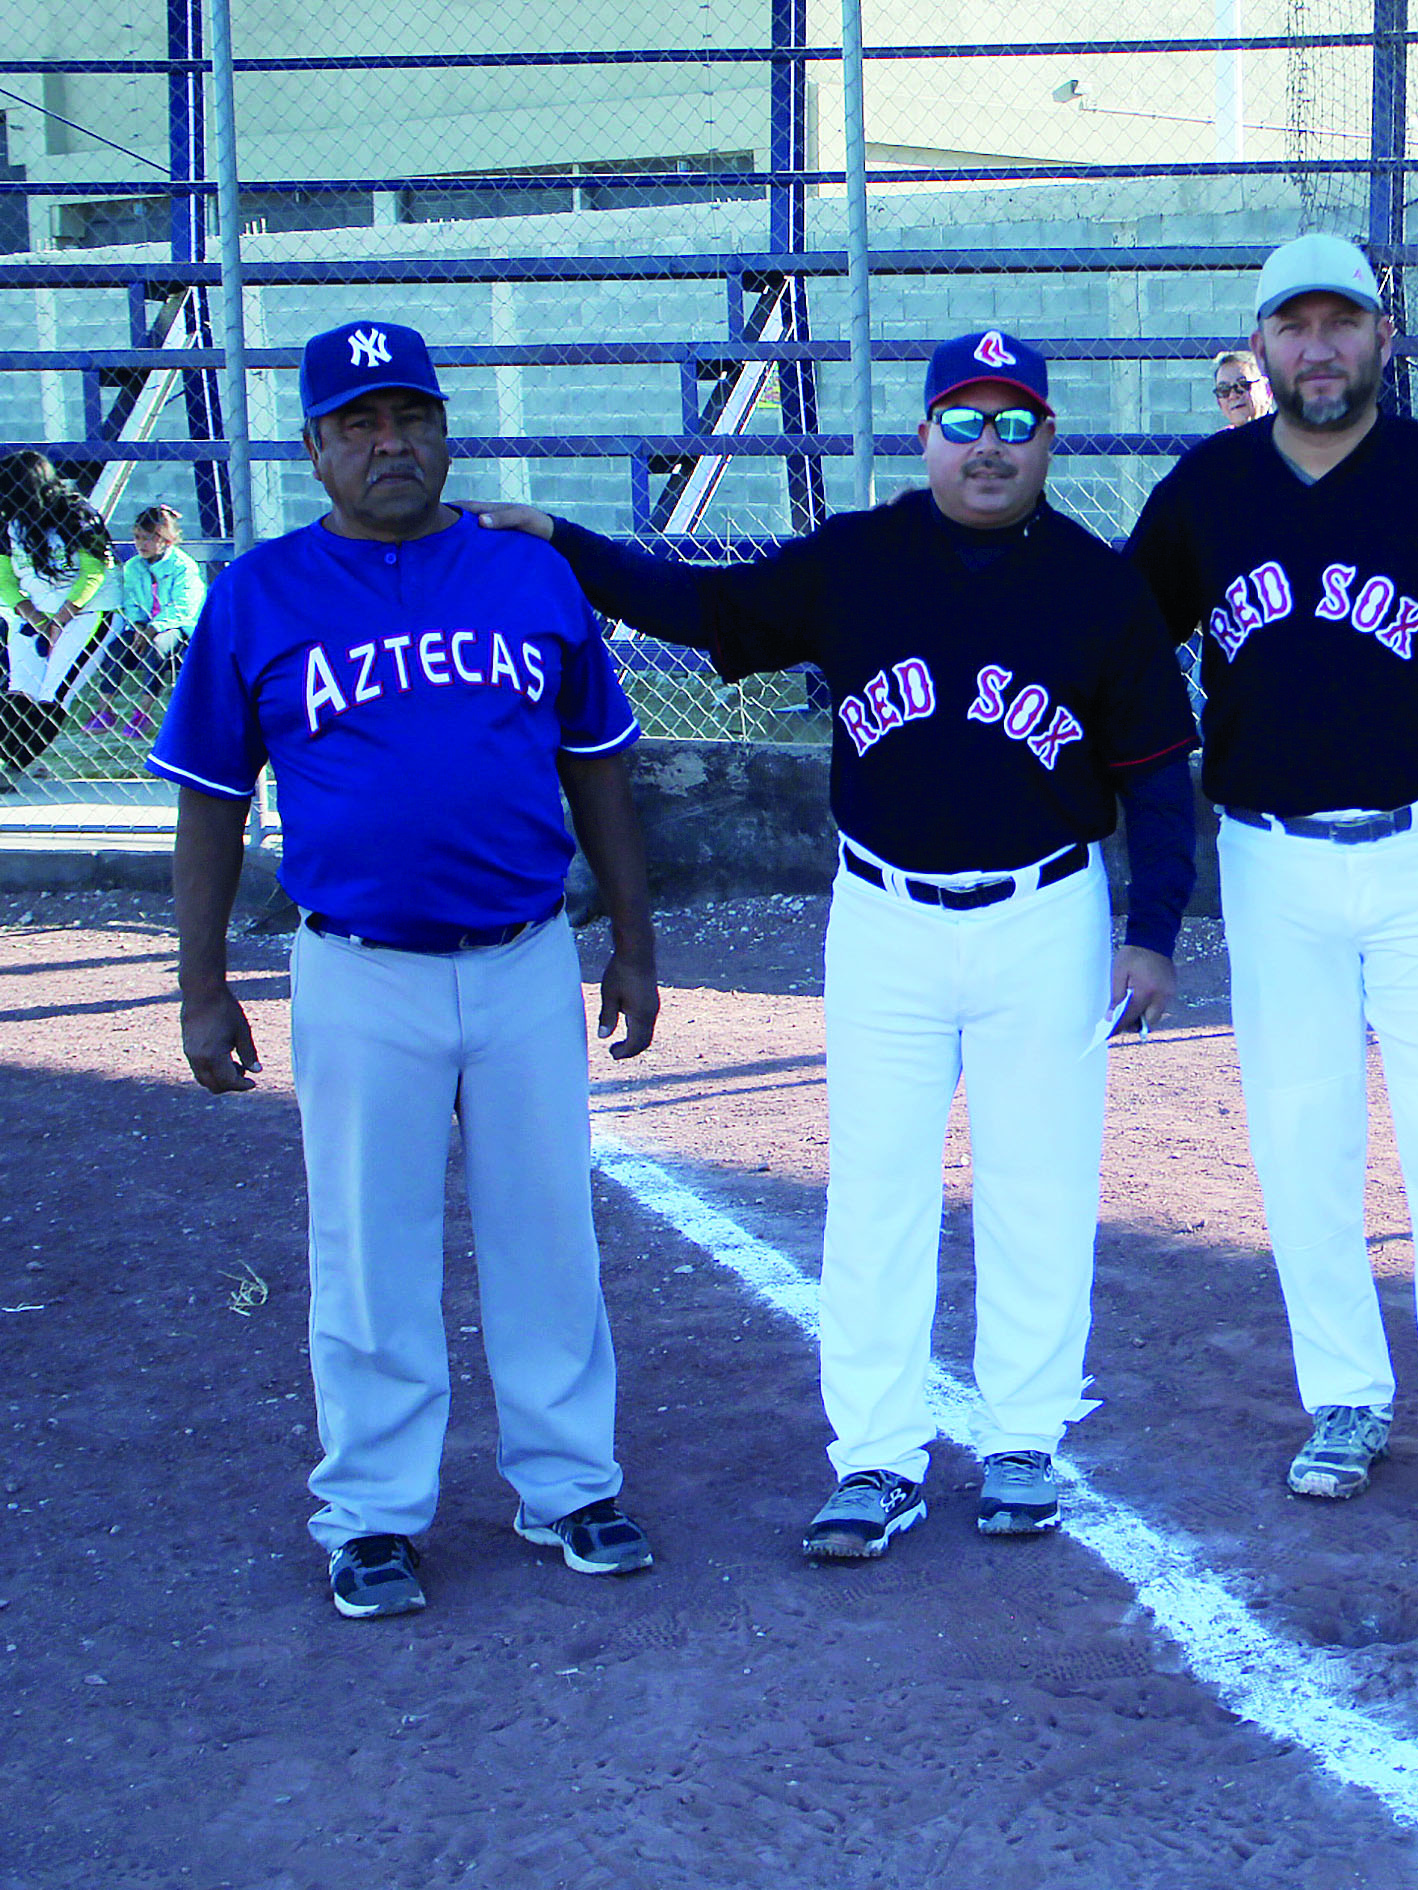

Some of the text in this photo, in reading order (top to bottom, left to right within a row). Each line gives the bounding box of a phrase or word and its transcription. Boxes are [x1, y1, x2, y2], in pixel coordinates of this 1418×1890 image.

[347, 328, 393, 368] NY
[1209, 561, 1292, 664] RED
[304, 629, 546, 738] AZTECAS
[838, 657, 1084, 771] RED SOX
